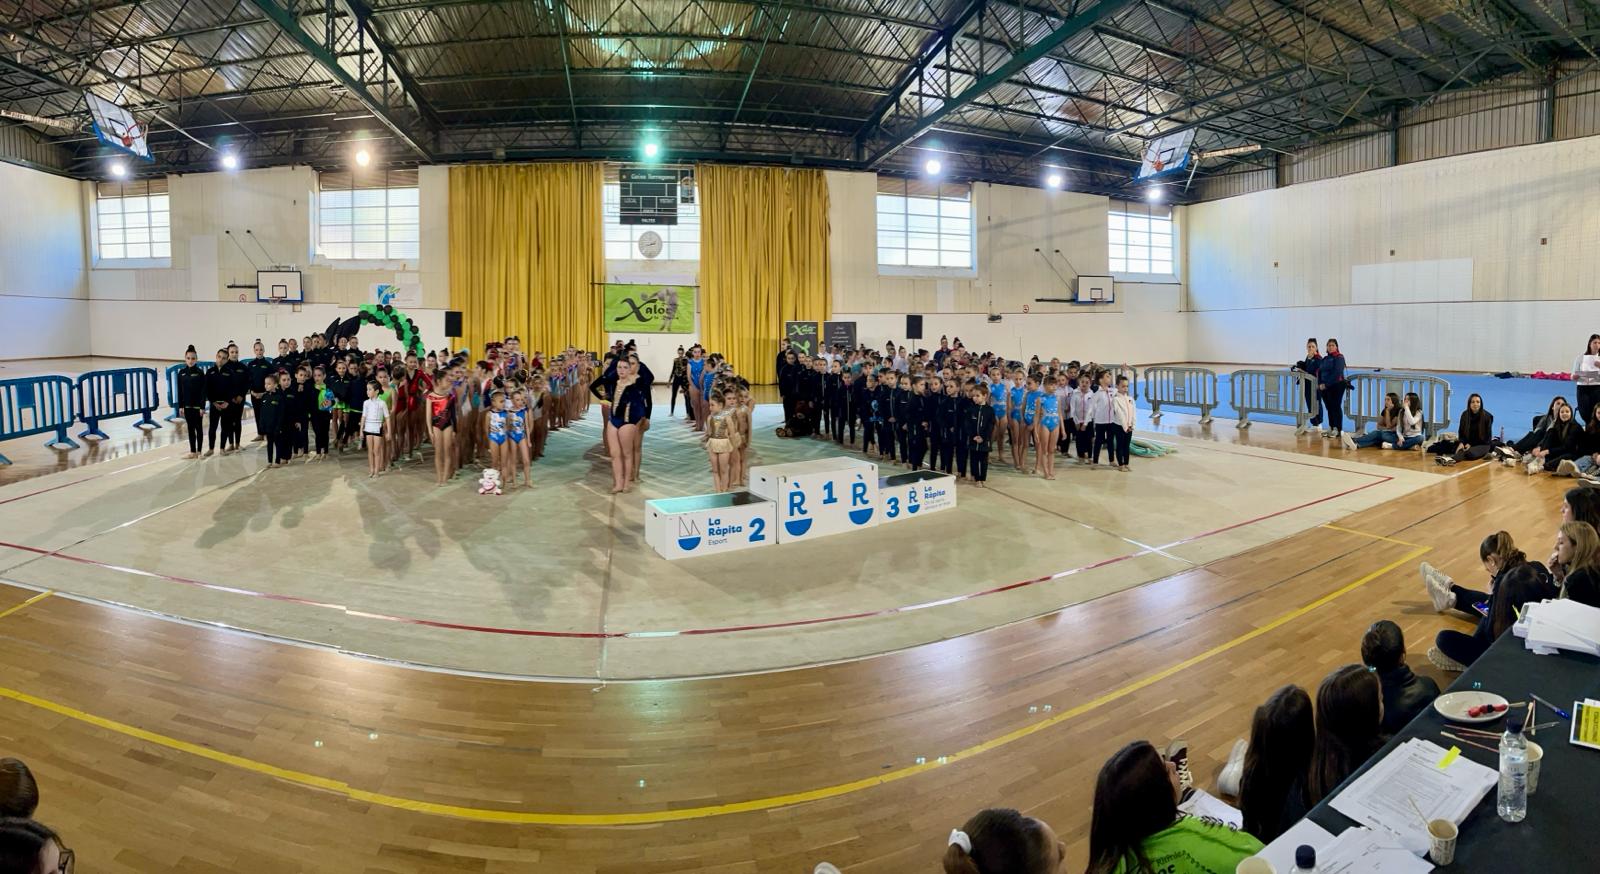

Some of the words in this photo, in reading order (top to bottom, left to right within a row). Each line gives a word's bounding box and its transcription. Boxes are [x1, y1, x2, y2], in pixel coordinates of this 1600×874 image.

[823, 481, 838, 504] 1
[886, 497, 900, 518] 3
[708, 518, 721, 526] La
[748, 518, 766, 542] 2
[708, 525, 742, 537] Ràpita
[708, 538, 728, 546] Esport
